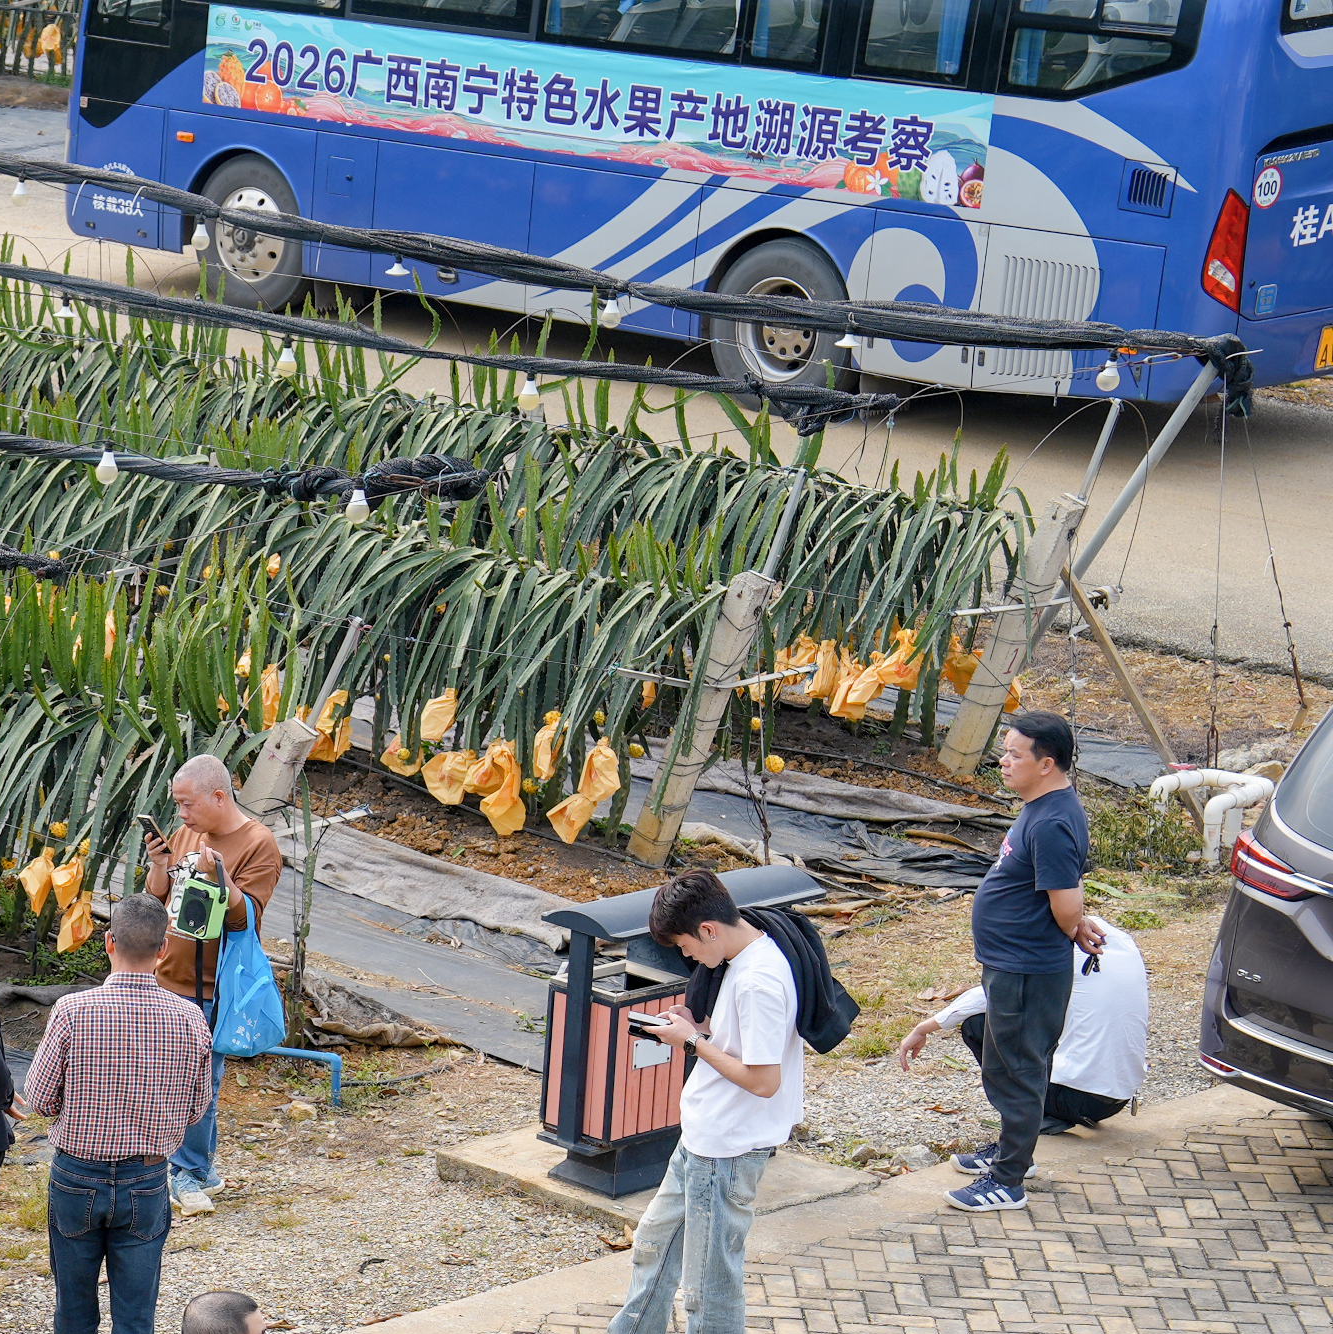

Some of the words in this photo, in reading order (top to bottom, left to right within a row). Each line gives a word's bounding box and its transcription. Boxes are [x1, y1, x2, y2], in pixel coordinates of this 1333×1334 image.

[244, 37, 935, 174] 2026广西南宁特色水果产地溯源考察
[1257, 180, 1278, 198] 100
